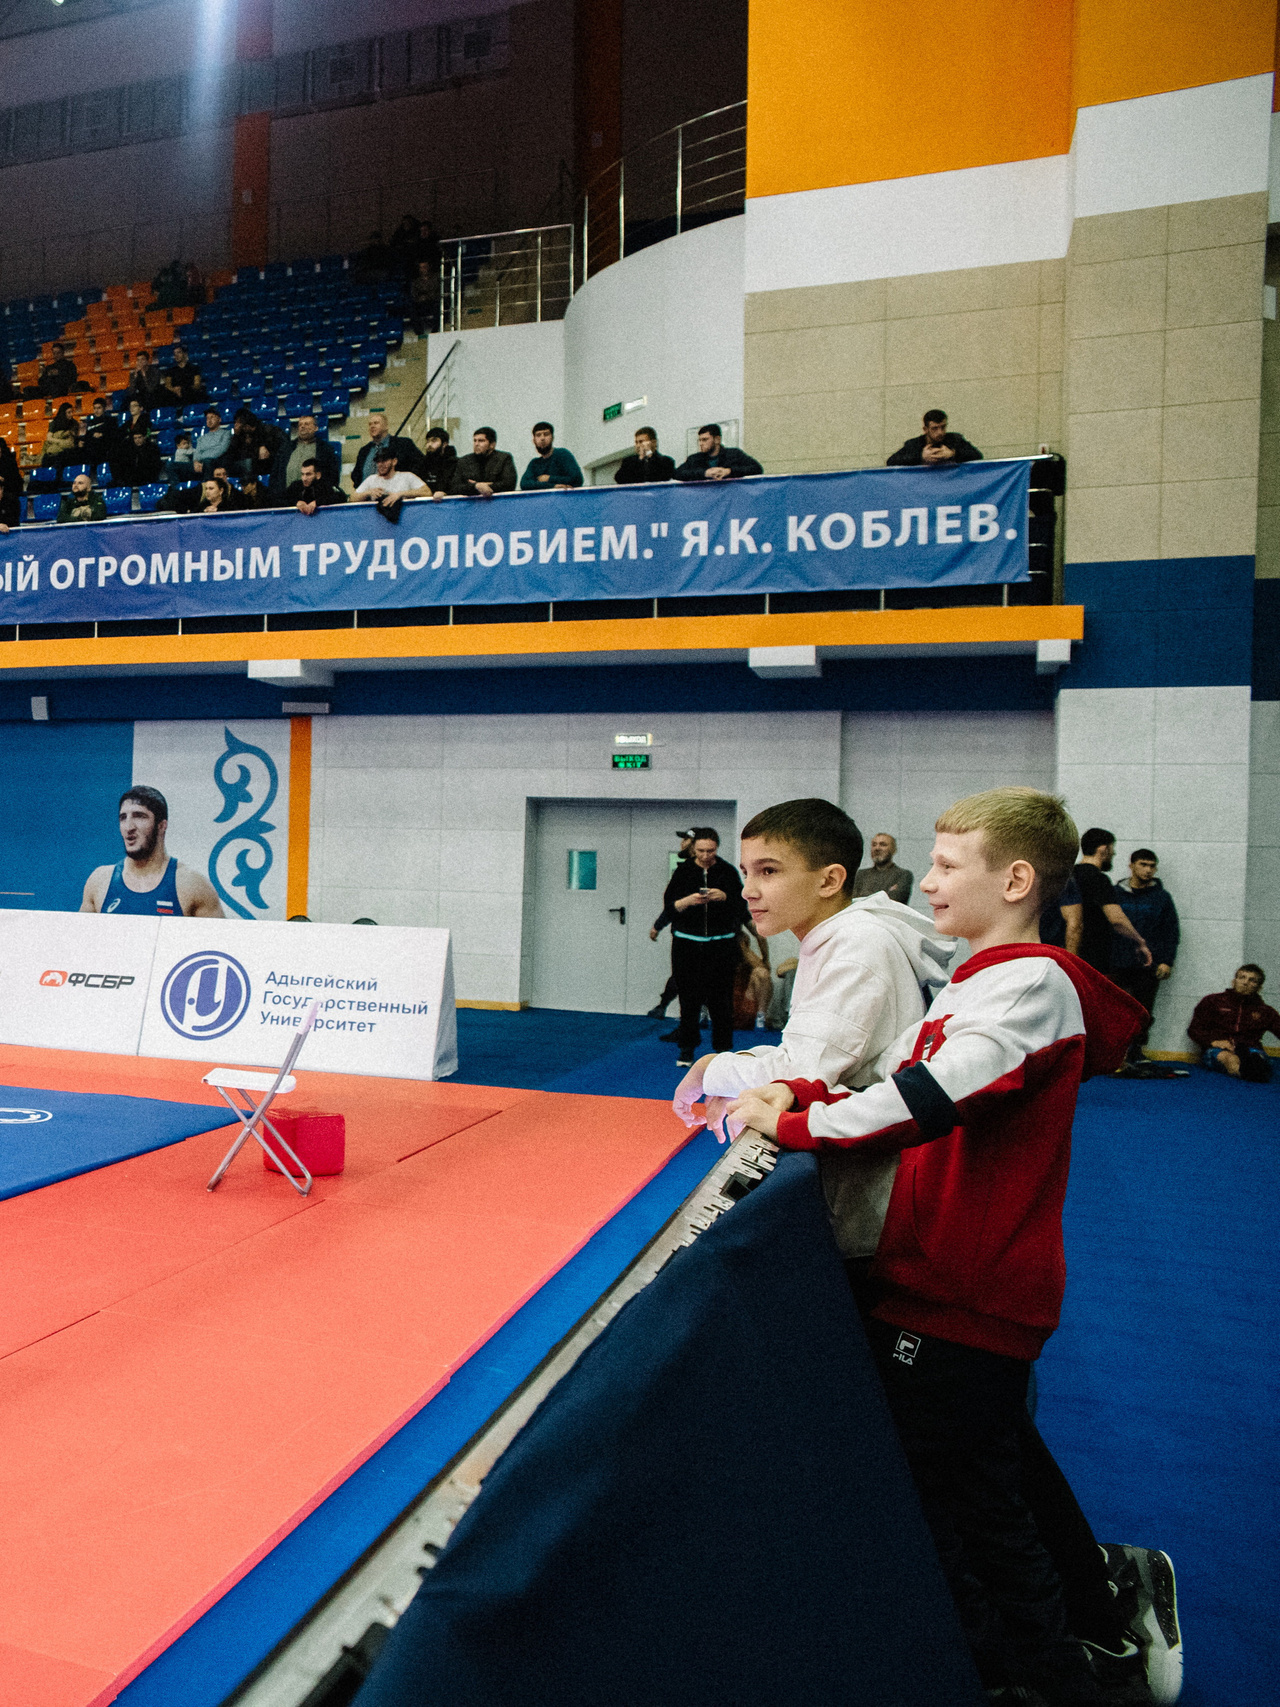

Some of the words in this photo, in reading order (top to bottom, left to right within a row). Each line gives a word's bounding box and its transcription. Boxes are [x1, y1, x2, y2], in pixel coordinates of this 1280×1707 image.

[49, 545, 281, 591] ОГРОМНЫМ
[291, 522, 668, 580] ТРУДОЛЮБИЕМ."
[681, 517, 772, 558] Я.К.
[787, 502, 1018, 552] КОБЛЕВ.
[67, 972, 136, 990] ФСБР
[265, 970, 378, 992] Адыгейский
[260, 1011, 377, 1033] Униврситет
